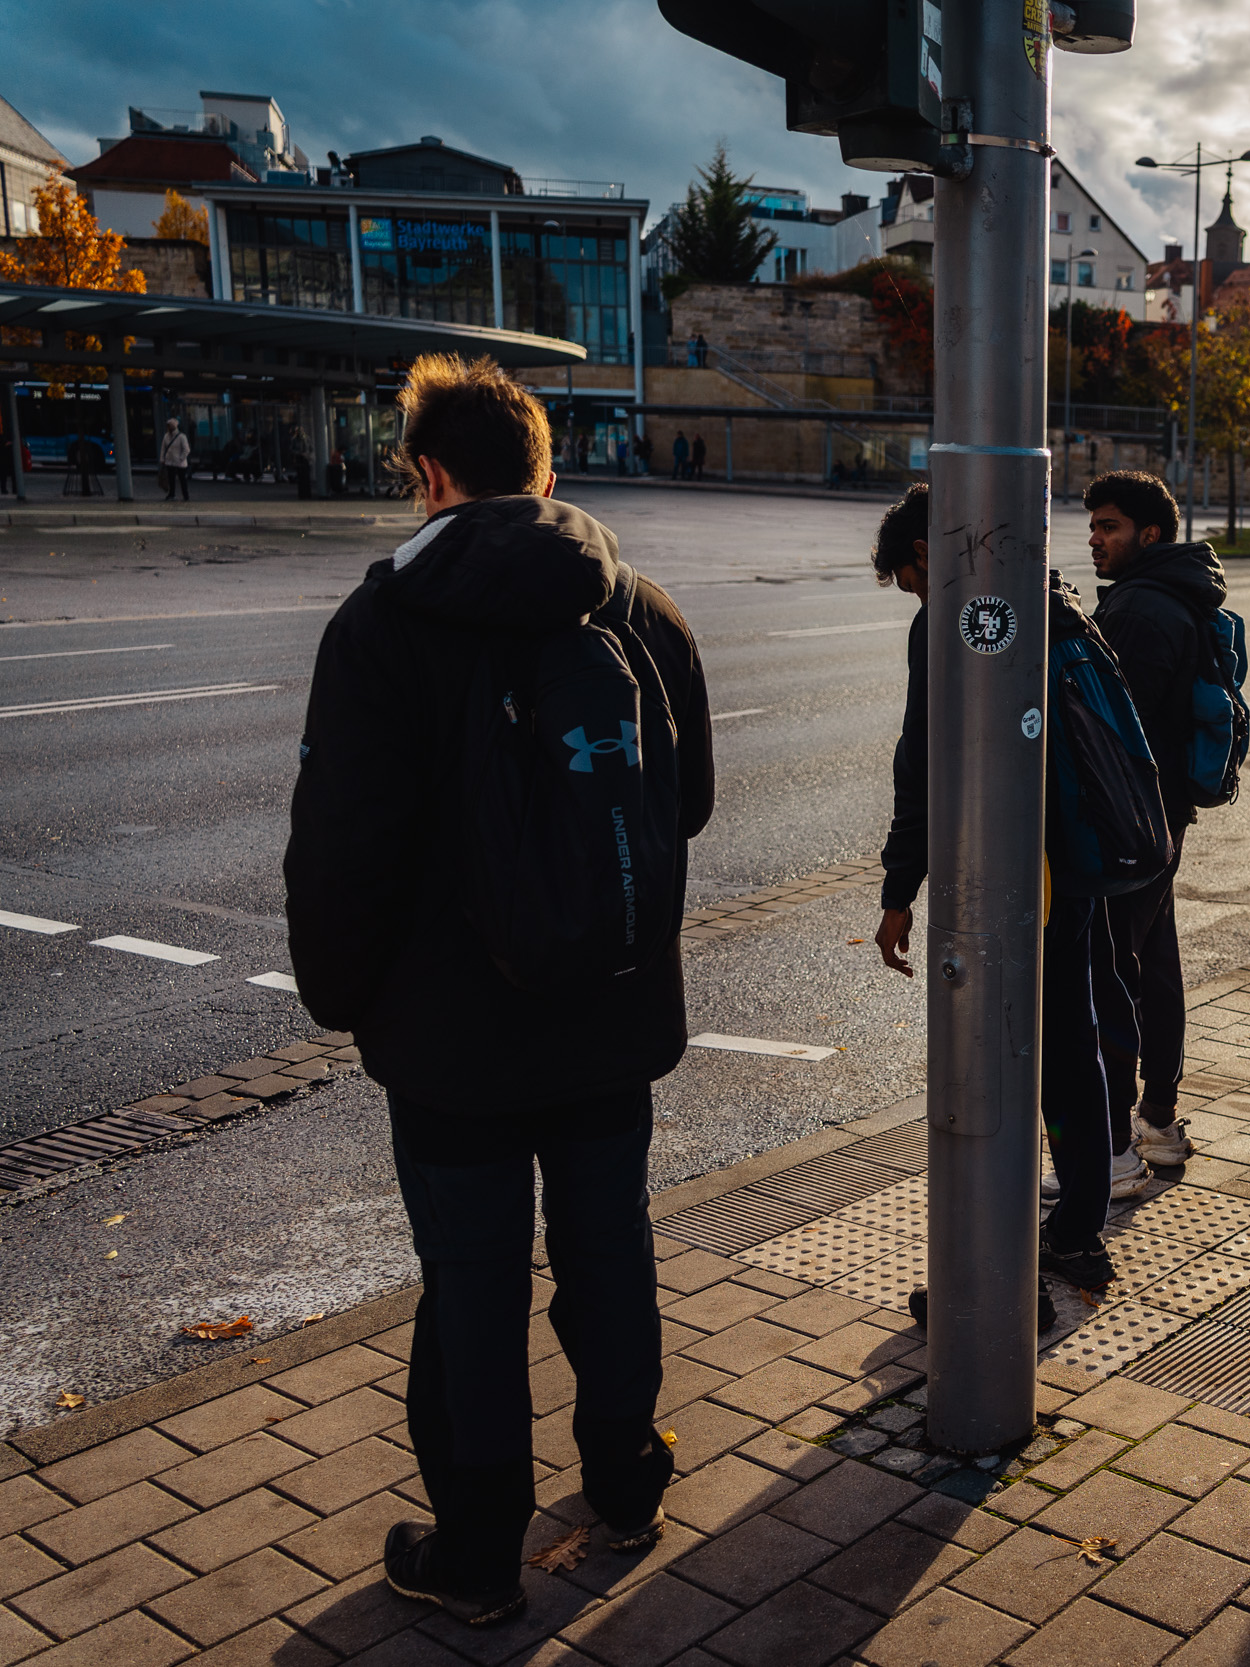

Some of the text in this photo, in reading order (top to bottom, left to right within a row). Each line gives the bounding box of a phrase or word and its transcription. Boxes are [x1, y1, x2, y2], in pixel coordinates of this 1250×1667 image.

[396, 218, 485, 236] Stadtwerke
[397, 233, 468, 252] Bayreuth
[976, 596, 1005, 608] AVANTI
[961, 604, 975, 644] BAYREUTH
[978, 611, 1001, 640] EHC
[610, 806, 632, 870] UNDER
[621, 871, 637, 946] ARMOUR
